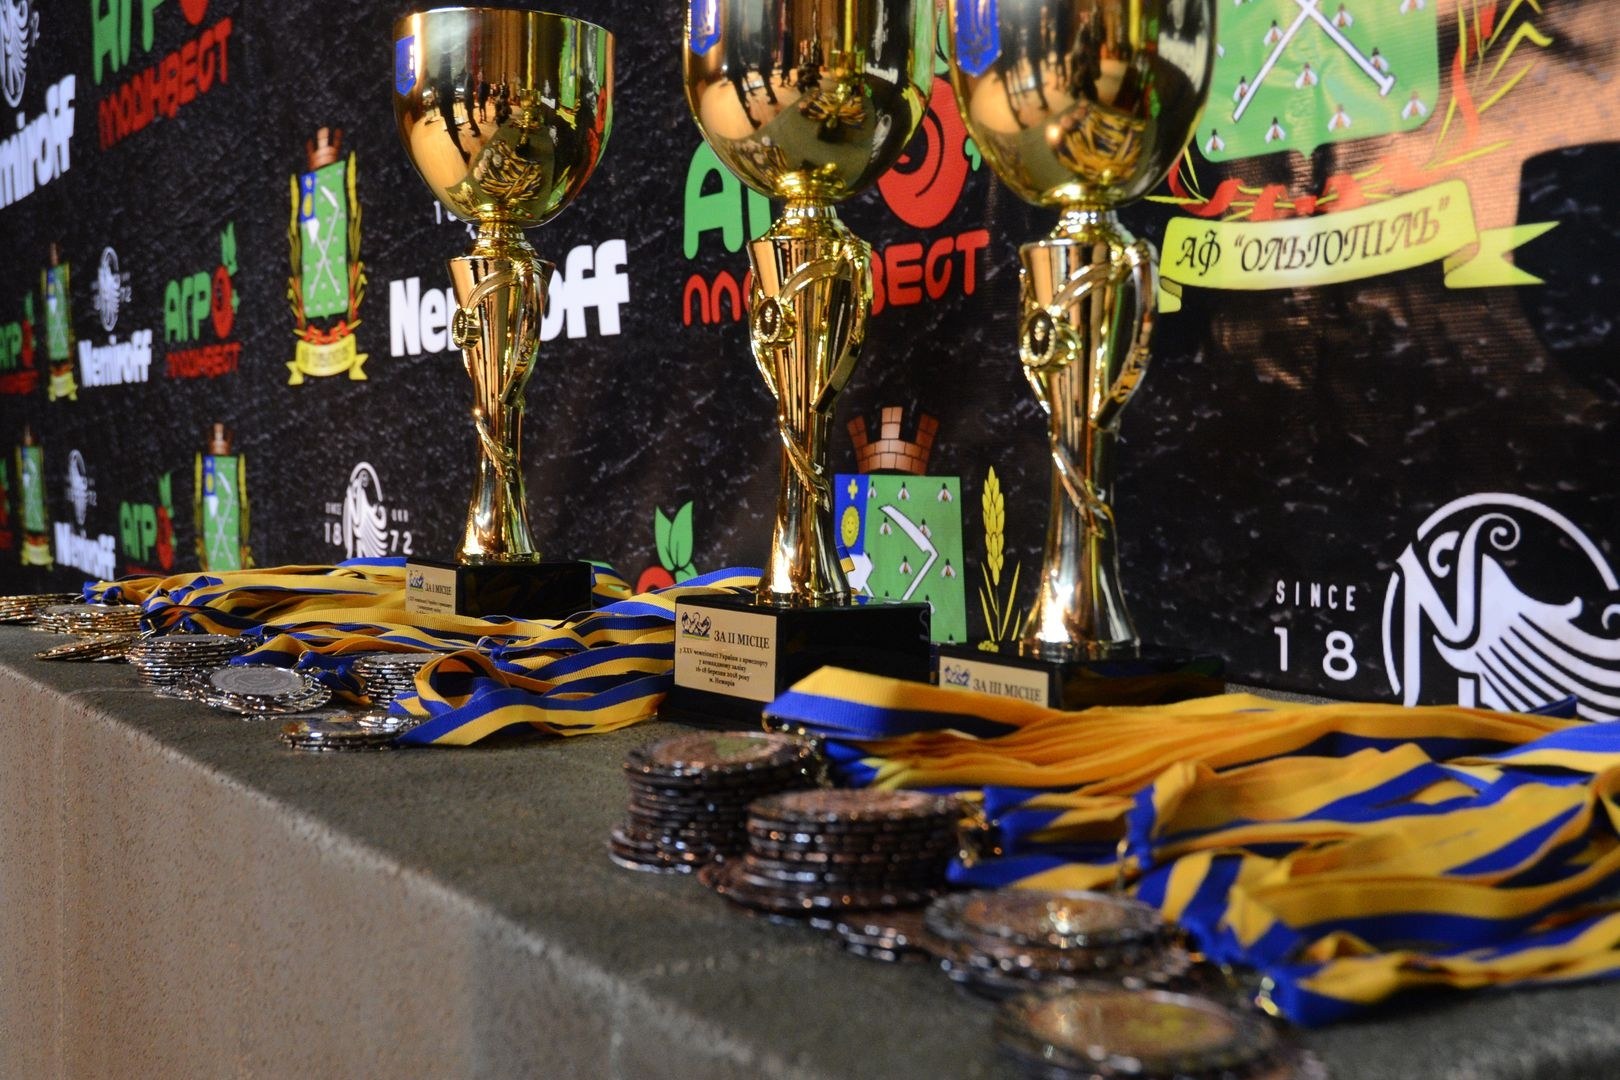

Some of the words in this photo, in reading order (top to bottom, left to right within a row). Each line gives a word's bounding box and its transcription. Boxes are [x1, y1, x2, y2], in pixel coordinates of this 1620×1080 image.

[1176, 230, 1221, 276] АФ
[389, 238, 630, 357] Neoff
[78, 328, 152, 387] Nemiroff
[390, 529, 413, 555] 72
[1275, 579, 1356, 612] SINCE
[714, 630, 726, 643] ЗА
[737, 633, 770, 650] МІСЦЕ
[973, 678, 987, 693] ЗА
[1004, 683, 1041, 702] МІСЦЕ
